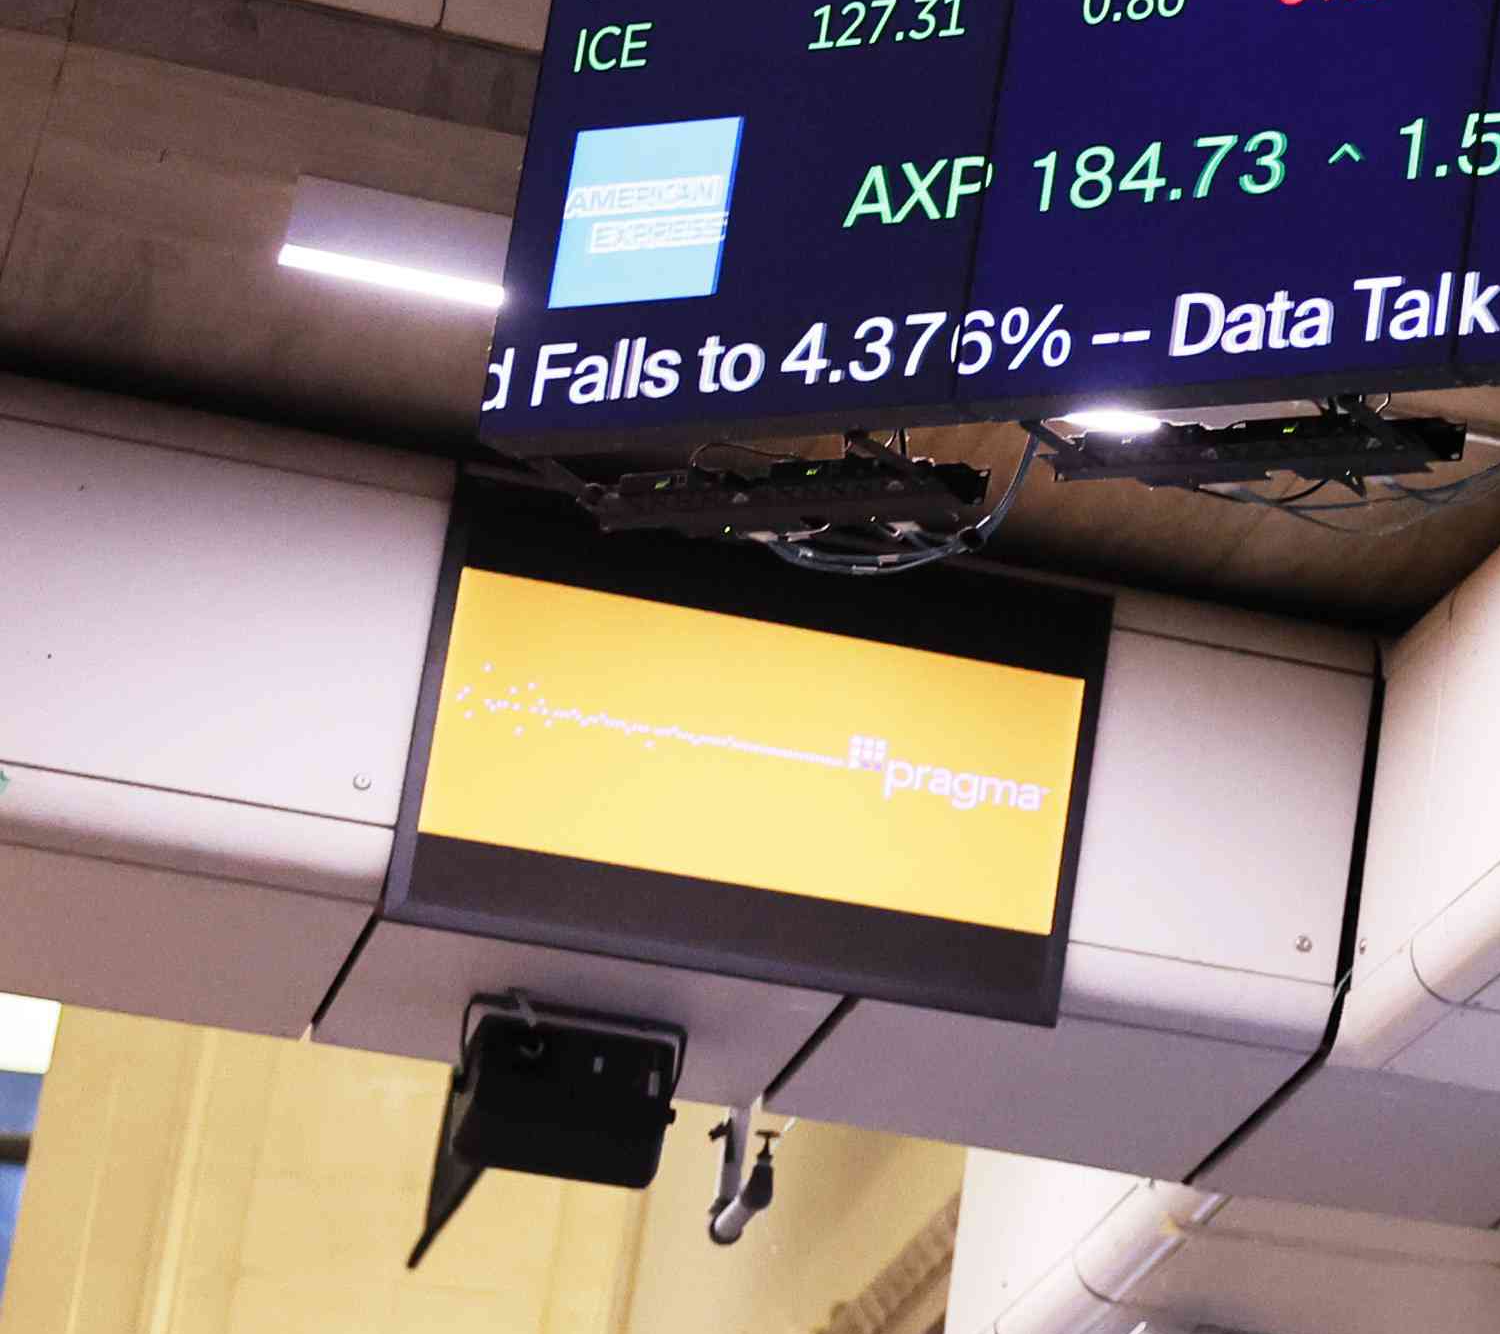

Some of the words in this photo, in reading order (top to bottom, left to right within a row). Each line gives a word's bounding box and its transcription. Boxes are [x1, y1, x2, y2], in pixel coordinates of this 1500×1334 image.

[574, 23, 652, 72] ICE
[564, 175, 723, 219] AMERICAN
[843, 156, 992, 227] AXP
[1034, 131, 1287, 211] 184.73
[589, 212, 728, 253] EXPRESS
[531, 337, 681, 406] Falls
[698, 336, 765, 392] to
[781, 304, 1071, 384] 4.376%
[1169, 291, 1334, 356] Data
[884, 758, 1041, 811] pragma
